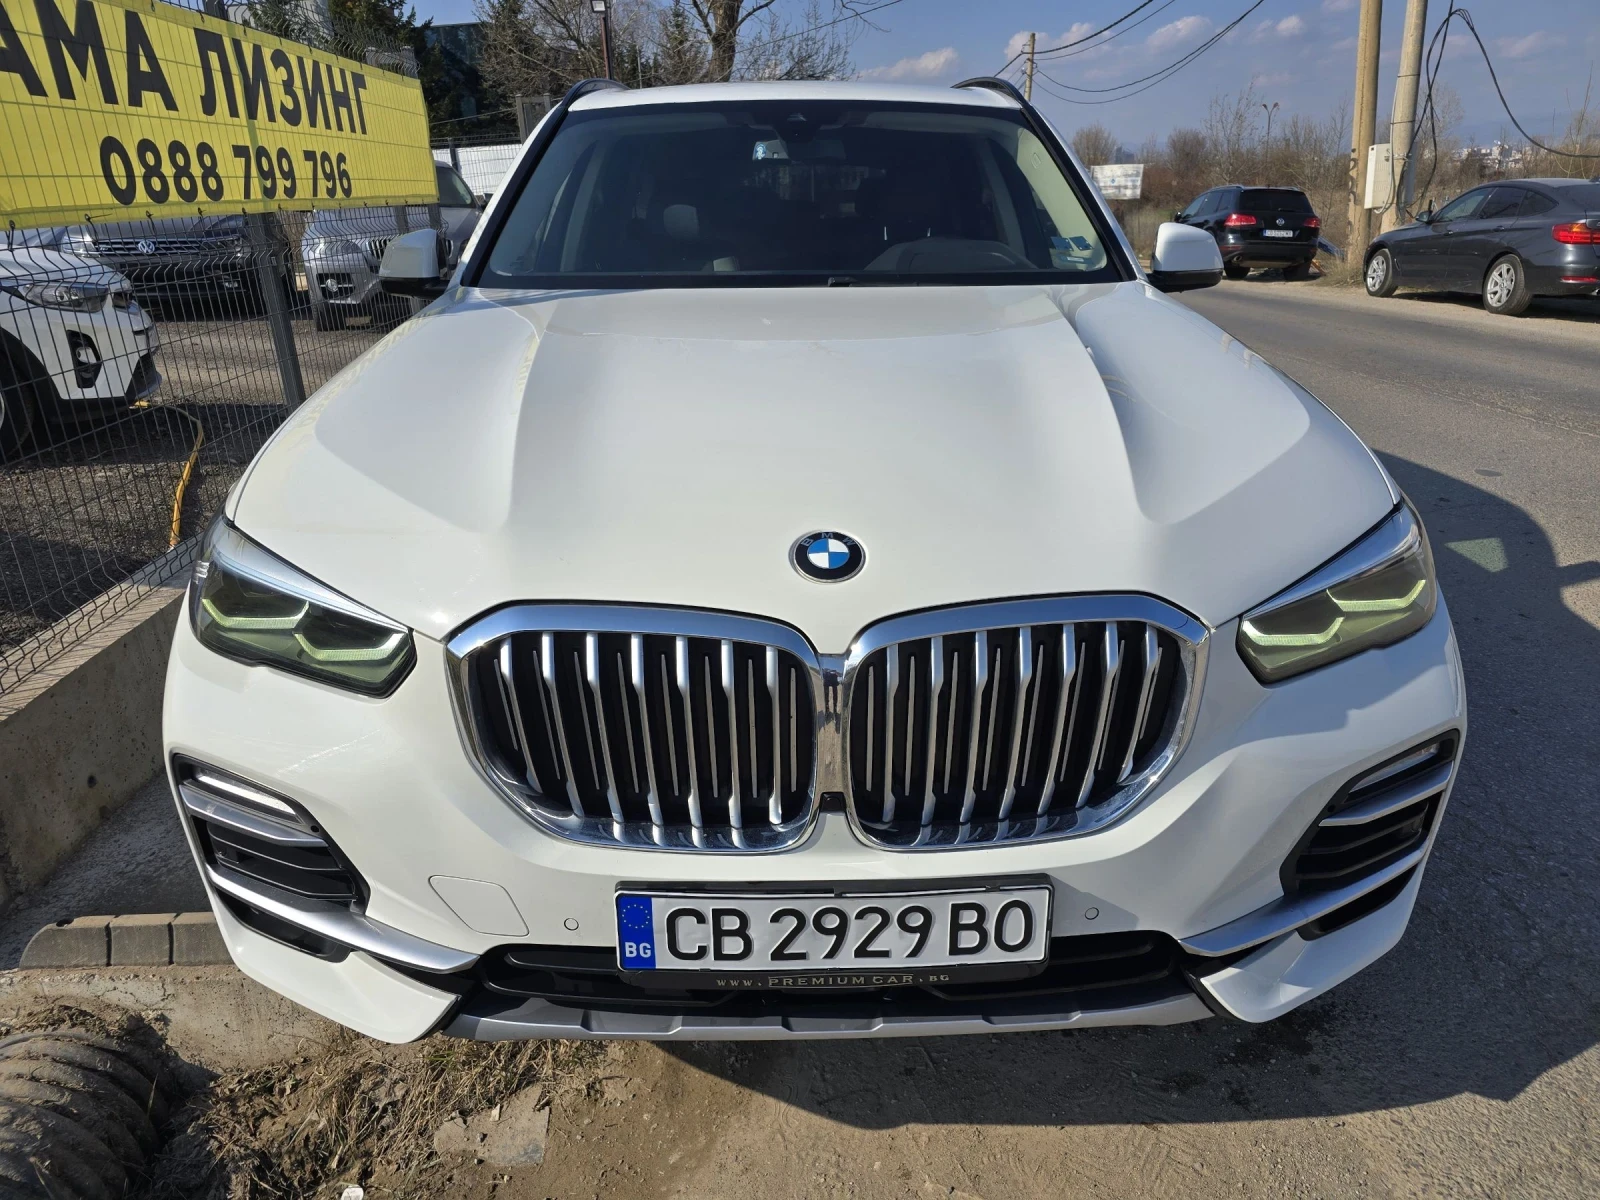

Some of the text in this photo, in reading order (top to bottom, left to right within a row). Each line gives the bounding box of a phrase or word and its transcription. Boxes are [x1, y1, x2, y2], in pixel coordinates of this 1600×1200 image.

[193, 27, 367, 135] ЛИЗИНГ
[100, 136, 352, 206] 0888 799 796
[800, 532, 856, 547] BMW
[624, 941, 652, 958] BG
[666, 907, 753, 961] CB
[769, 904, 933, 960] 2929
